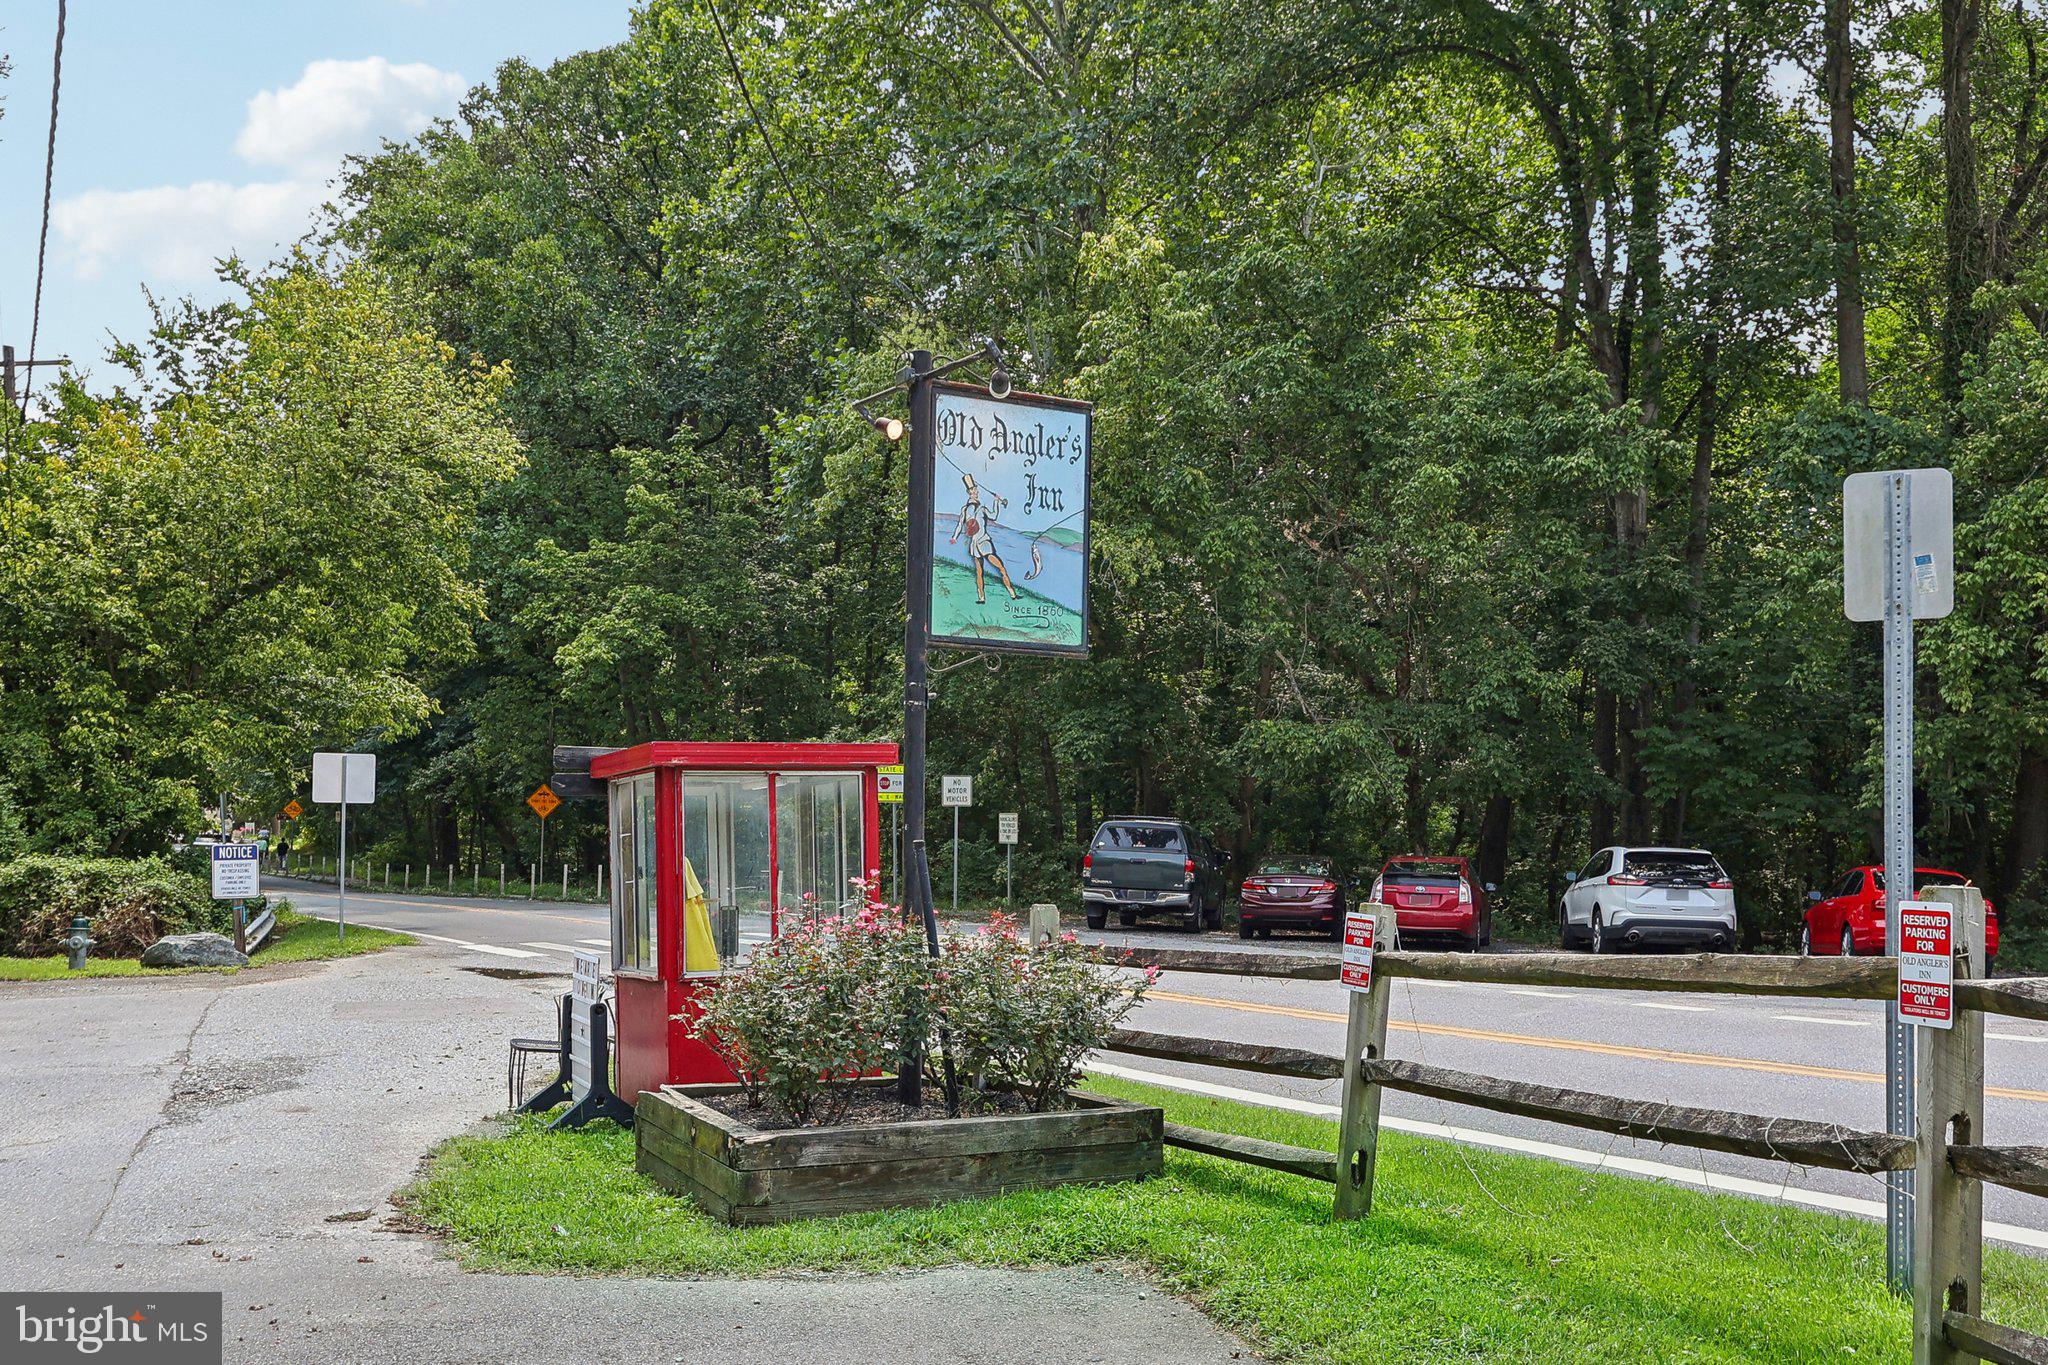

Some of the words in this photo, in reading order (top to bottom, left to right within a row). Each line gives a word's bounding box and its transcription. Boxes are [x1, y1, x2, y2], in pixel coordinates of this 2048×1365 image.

[937, 409, 983, 451] Old
[988, 412, 1083, 467] Angler's
[1024, 473, 1065, 515] Inn
[1037, 605, 1063, 617] 1860
[219, 846, 253, 859] NOTICE
[1347, 920, 1372, 930] RESERVED
[1903, 914, 1948, 927] RESERVED
[1348, 929, 1371, 938] PARKING
[1905, 927, 1946, 940] PARKING
[1353, 937, 1364, 945] FOR
[1916, 941, 1934, 952] FOR
[1903, 956, 1916, 966] OLD
[1917, 957, 1949, 968] ANGLER'S
[1343, 964, 1369, 974] CUSTOMERS
[1349, 971, 1362, 979] ONLY
[1918, 970, 1931, 979] INN
[1901, 983, 1949, 997] CUSTOMERS
[1914, 994, 1936, 1006] ONLY
